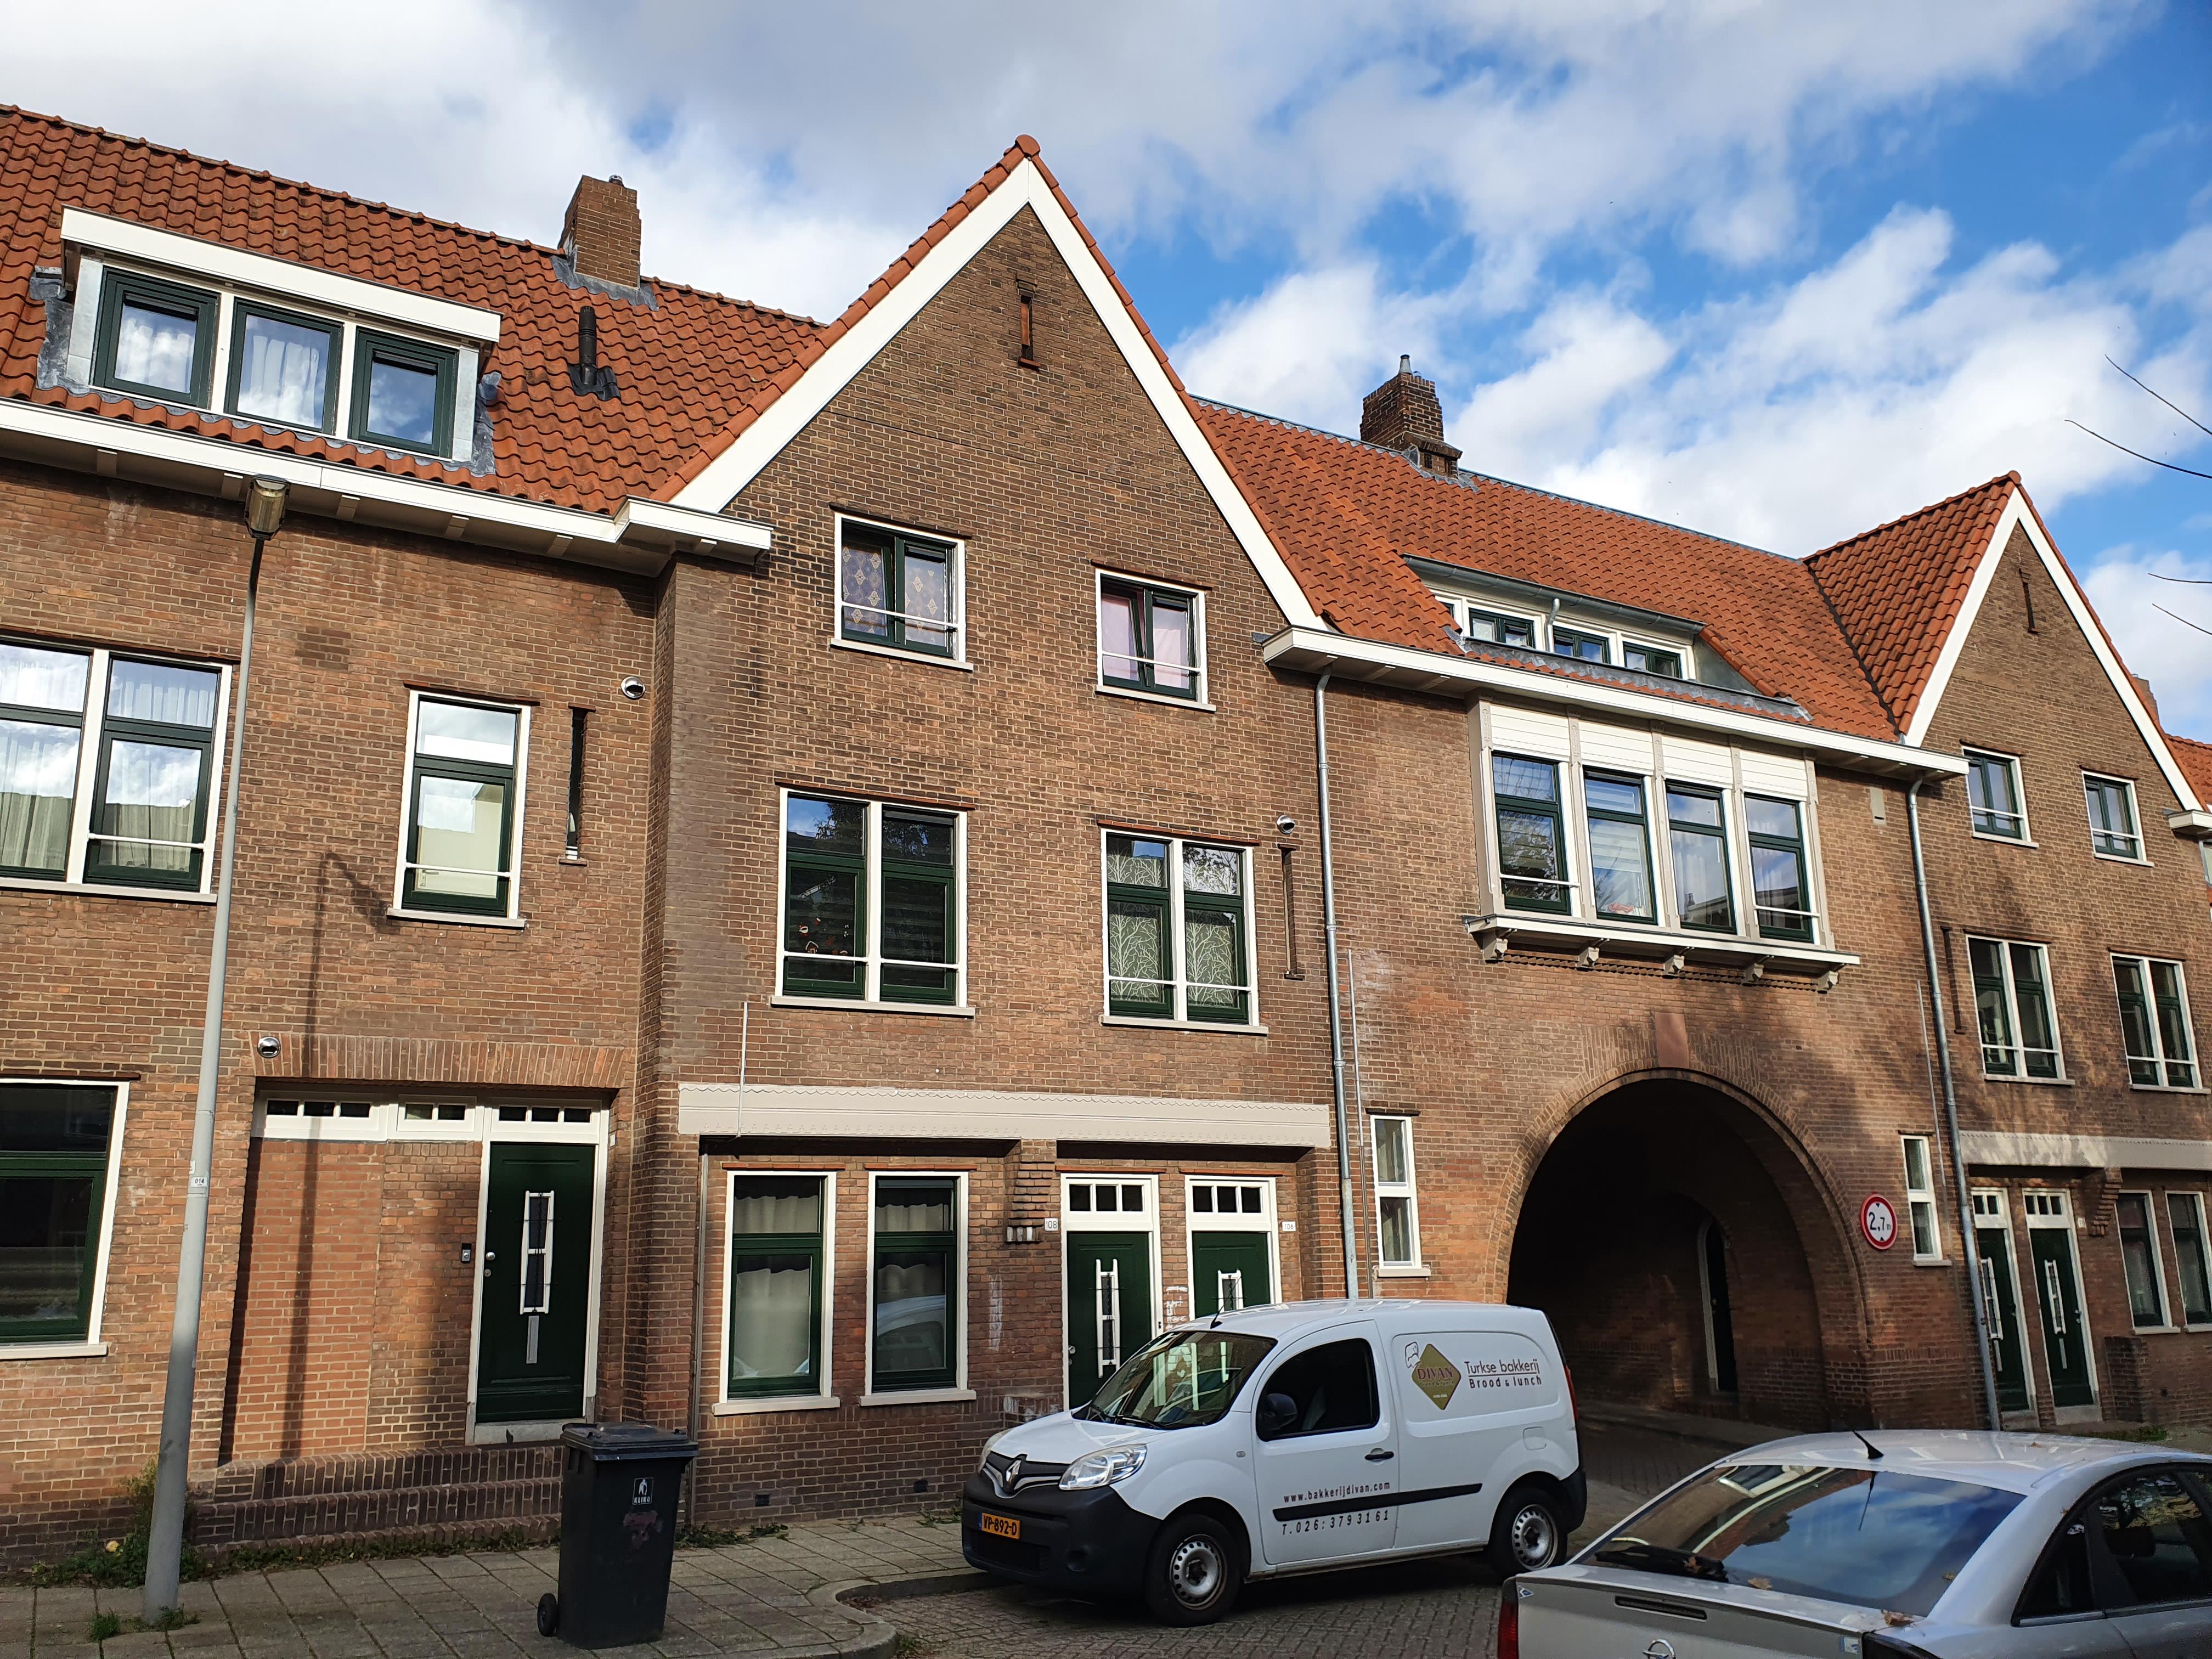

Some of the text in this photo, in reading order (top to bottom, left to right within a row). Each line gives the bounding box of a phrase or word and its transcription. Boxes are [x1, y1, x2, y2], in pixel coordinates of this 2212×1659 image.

[1046, 1220, 1057, 1229] 108
[1417, 1367, 1454, 1380] DIVAN
[1464, 1358, 1541, 1374] Turkse bakkerij
[1469, 1377, 1502, 1389] Brood
[1513, 1375, 1542, 1386] lunch
[1283, 1482, 1390, 1503] www.bakkerijdivan.com
[983, 1515, 1018, 1536] VP-892-D
